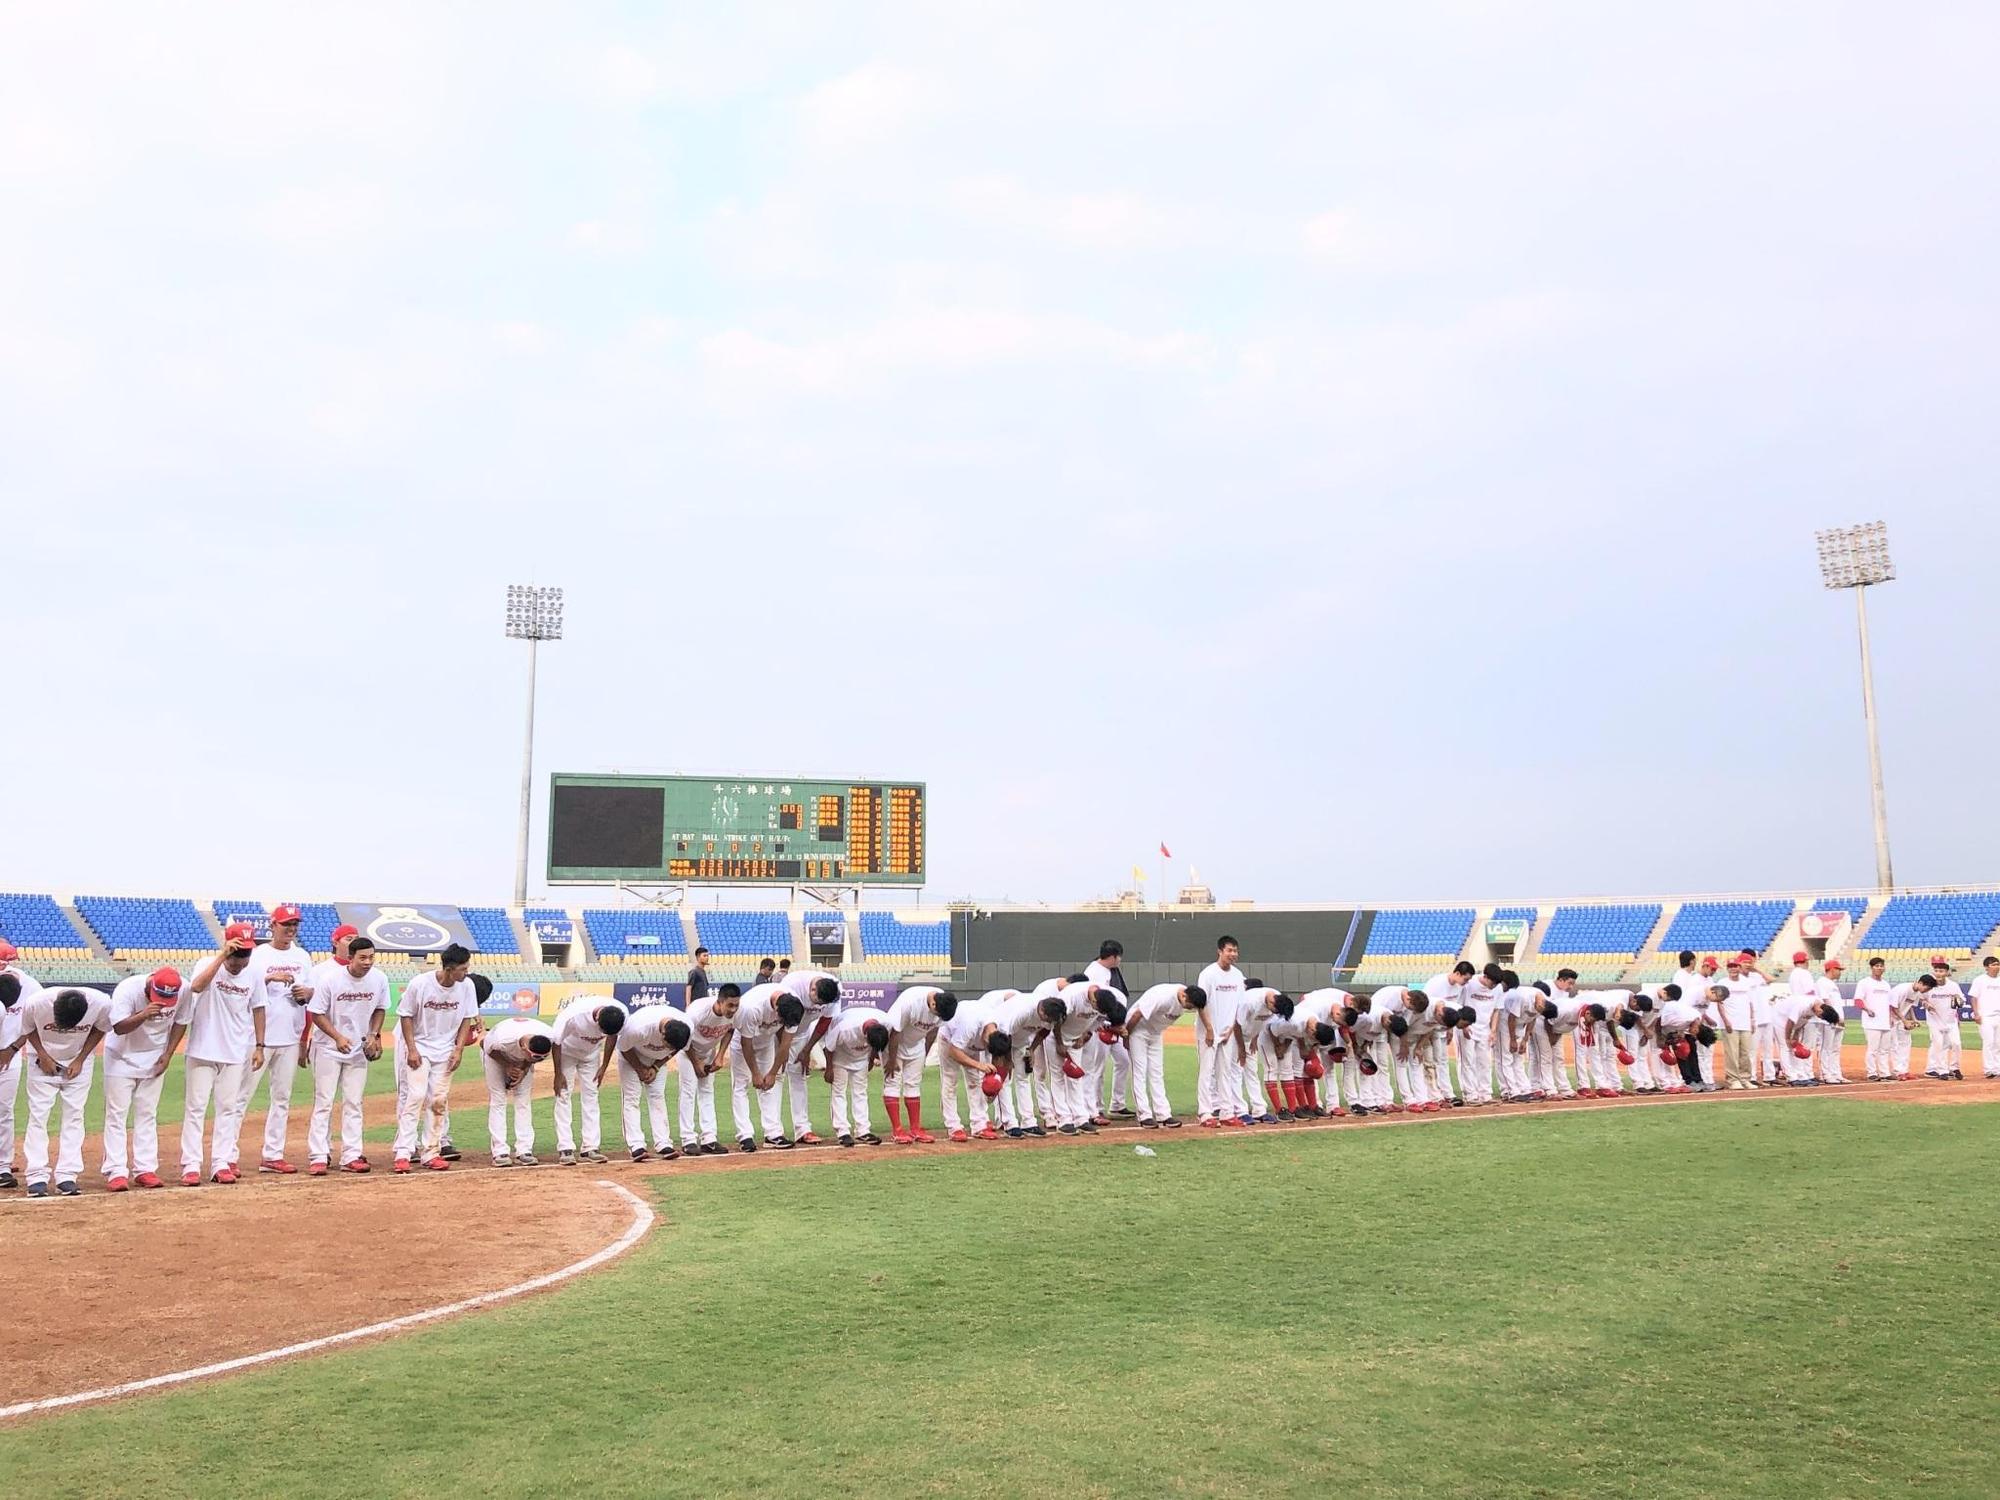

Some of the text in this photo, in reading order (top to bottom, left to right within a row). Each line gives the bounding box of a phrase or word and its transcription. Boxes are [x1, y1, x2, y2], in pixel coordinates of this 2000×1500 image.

[713, 783, 792, 796] 斗六棒球場
[242, 929, 252, 939] W
